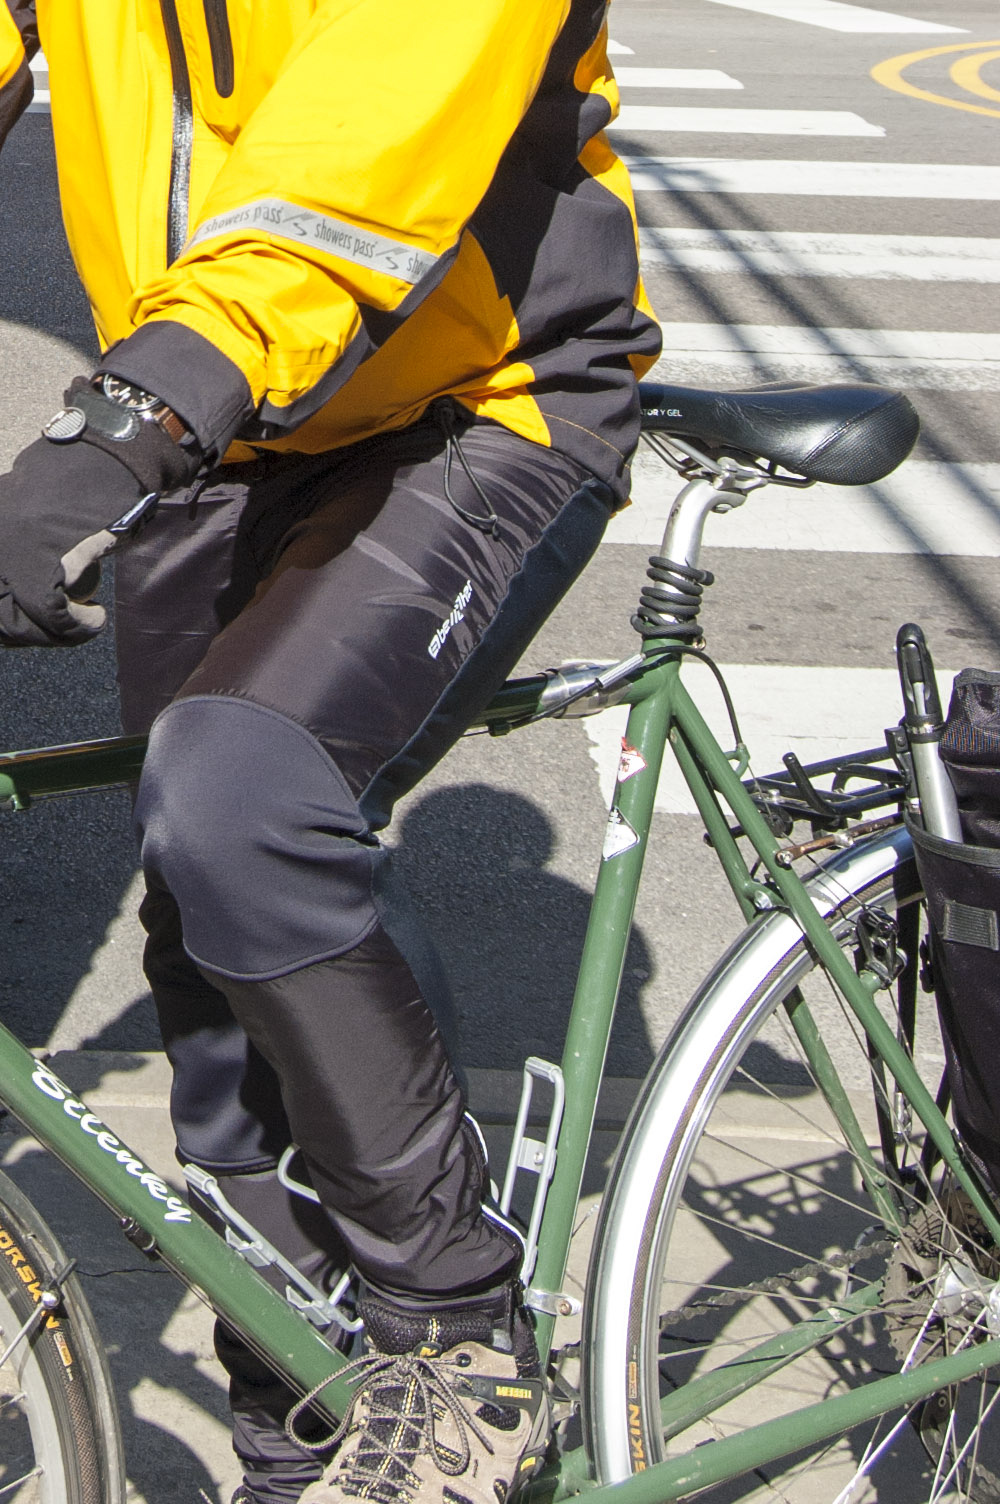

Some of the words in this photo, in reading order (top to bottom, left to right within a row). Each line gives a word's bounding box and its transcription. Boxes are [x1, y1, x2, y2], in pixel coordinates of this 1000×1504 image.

[203, 209, 251, 234] showers
[253, 204, 284, 229] pass
[314, 218, 352, 247] showers
[352, 238, 378, 259] pass
[32, 1058, 192, 1223] Bilenky
